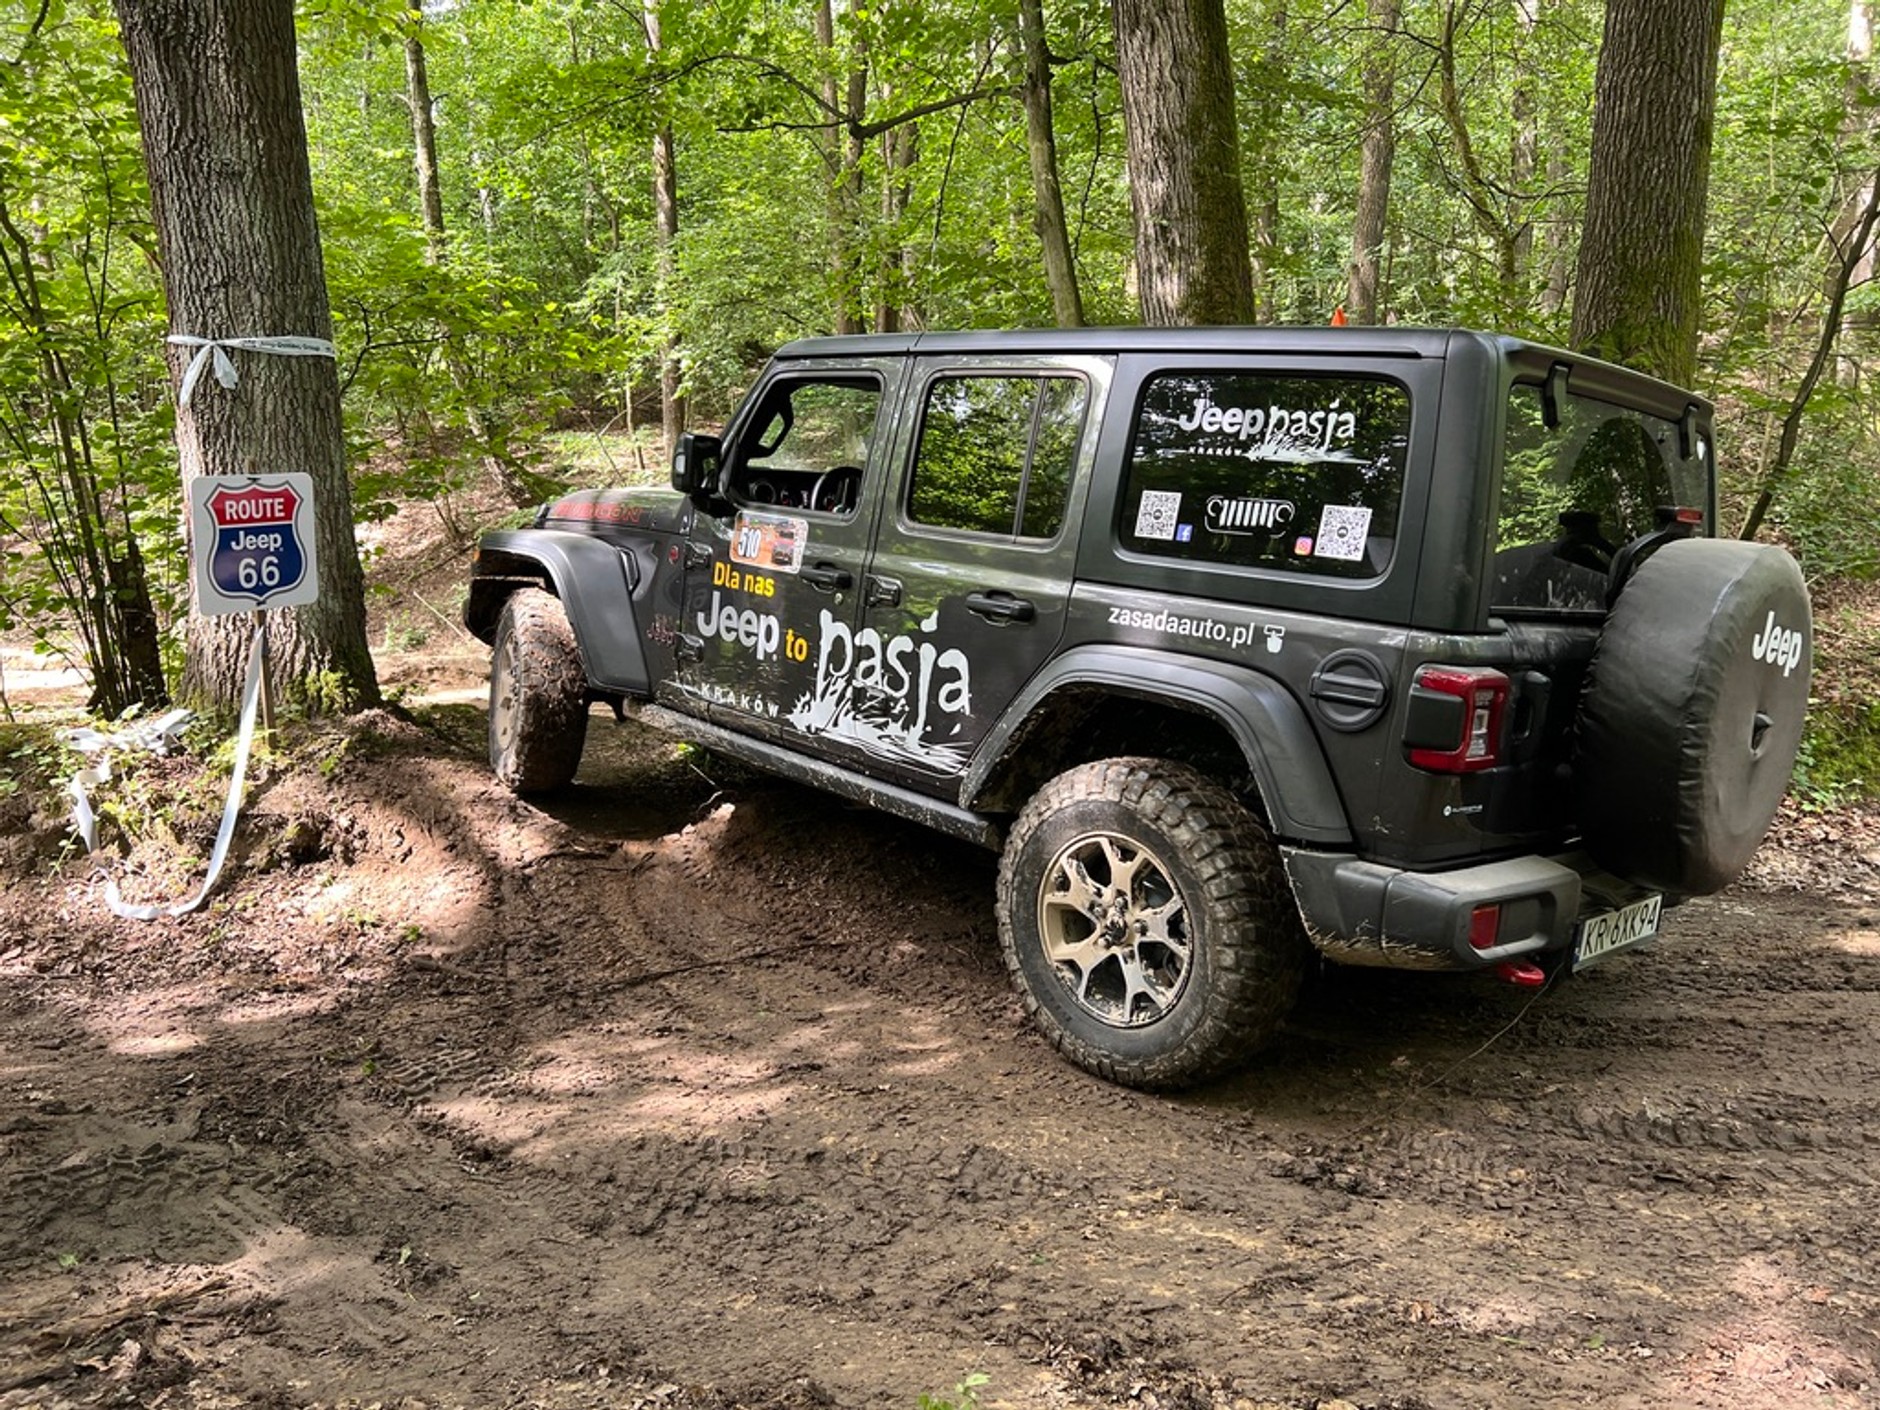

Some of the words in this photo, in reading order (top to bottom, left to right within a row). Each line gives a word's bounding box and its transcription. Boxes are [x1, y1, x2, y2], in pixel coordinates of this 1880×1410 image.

[1178, 399, 1265, 440] Jeep
[1264, 397, 1356, 453] pasja
[225, 498, 285, 521] ROUTE
[231, 530, 282, 551] Jeep
[238, 556, 280, 588] 66
[713, 561, 740, 590] Dla
[743, 573, 776, 597] nas
[1108, 606, 1255, 649] zasadaauto.pl
[1752, 610, 1803, 677] Jeep
[696, 591, 780, 660] Jeep
[785, 628, 808, 662] to
[813, 607, 971, 735] pasja
[701, 683, 779, 717] KRAKÓW
[1582, 918, 1608, 957] KR
[1610, 899, 1659, 946] 6XK94
